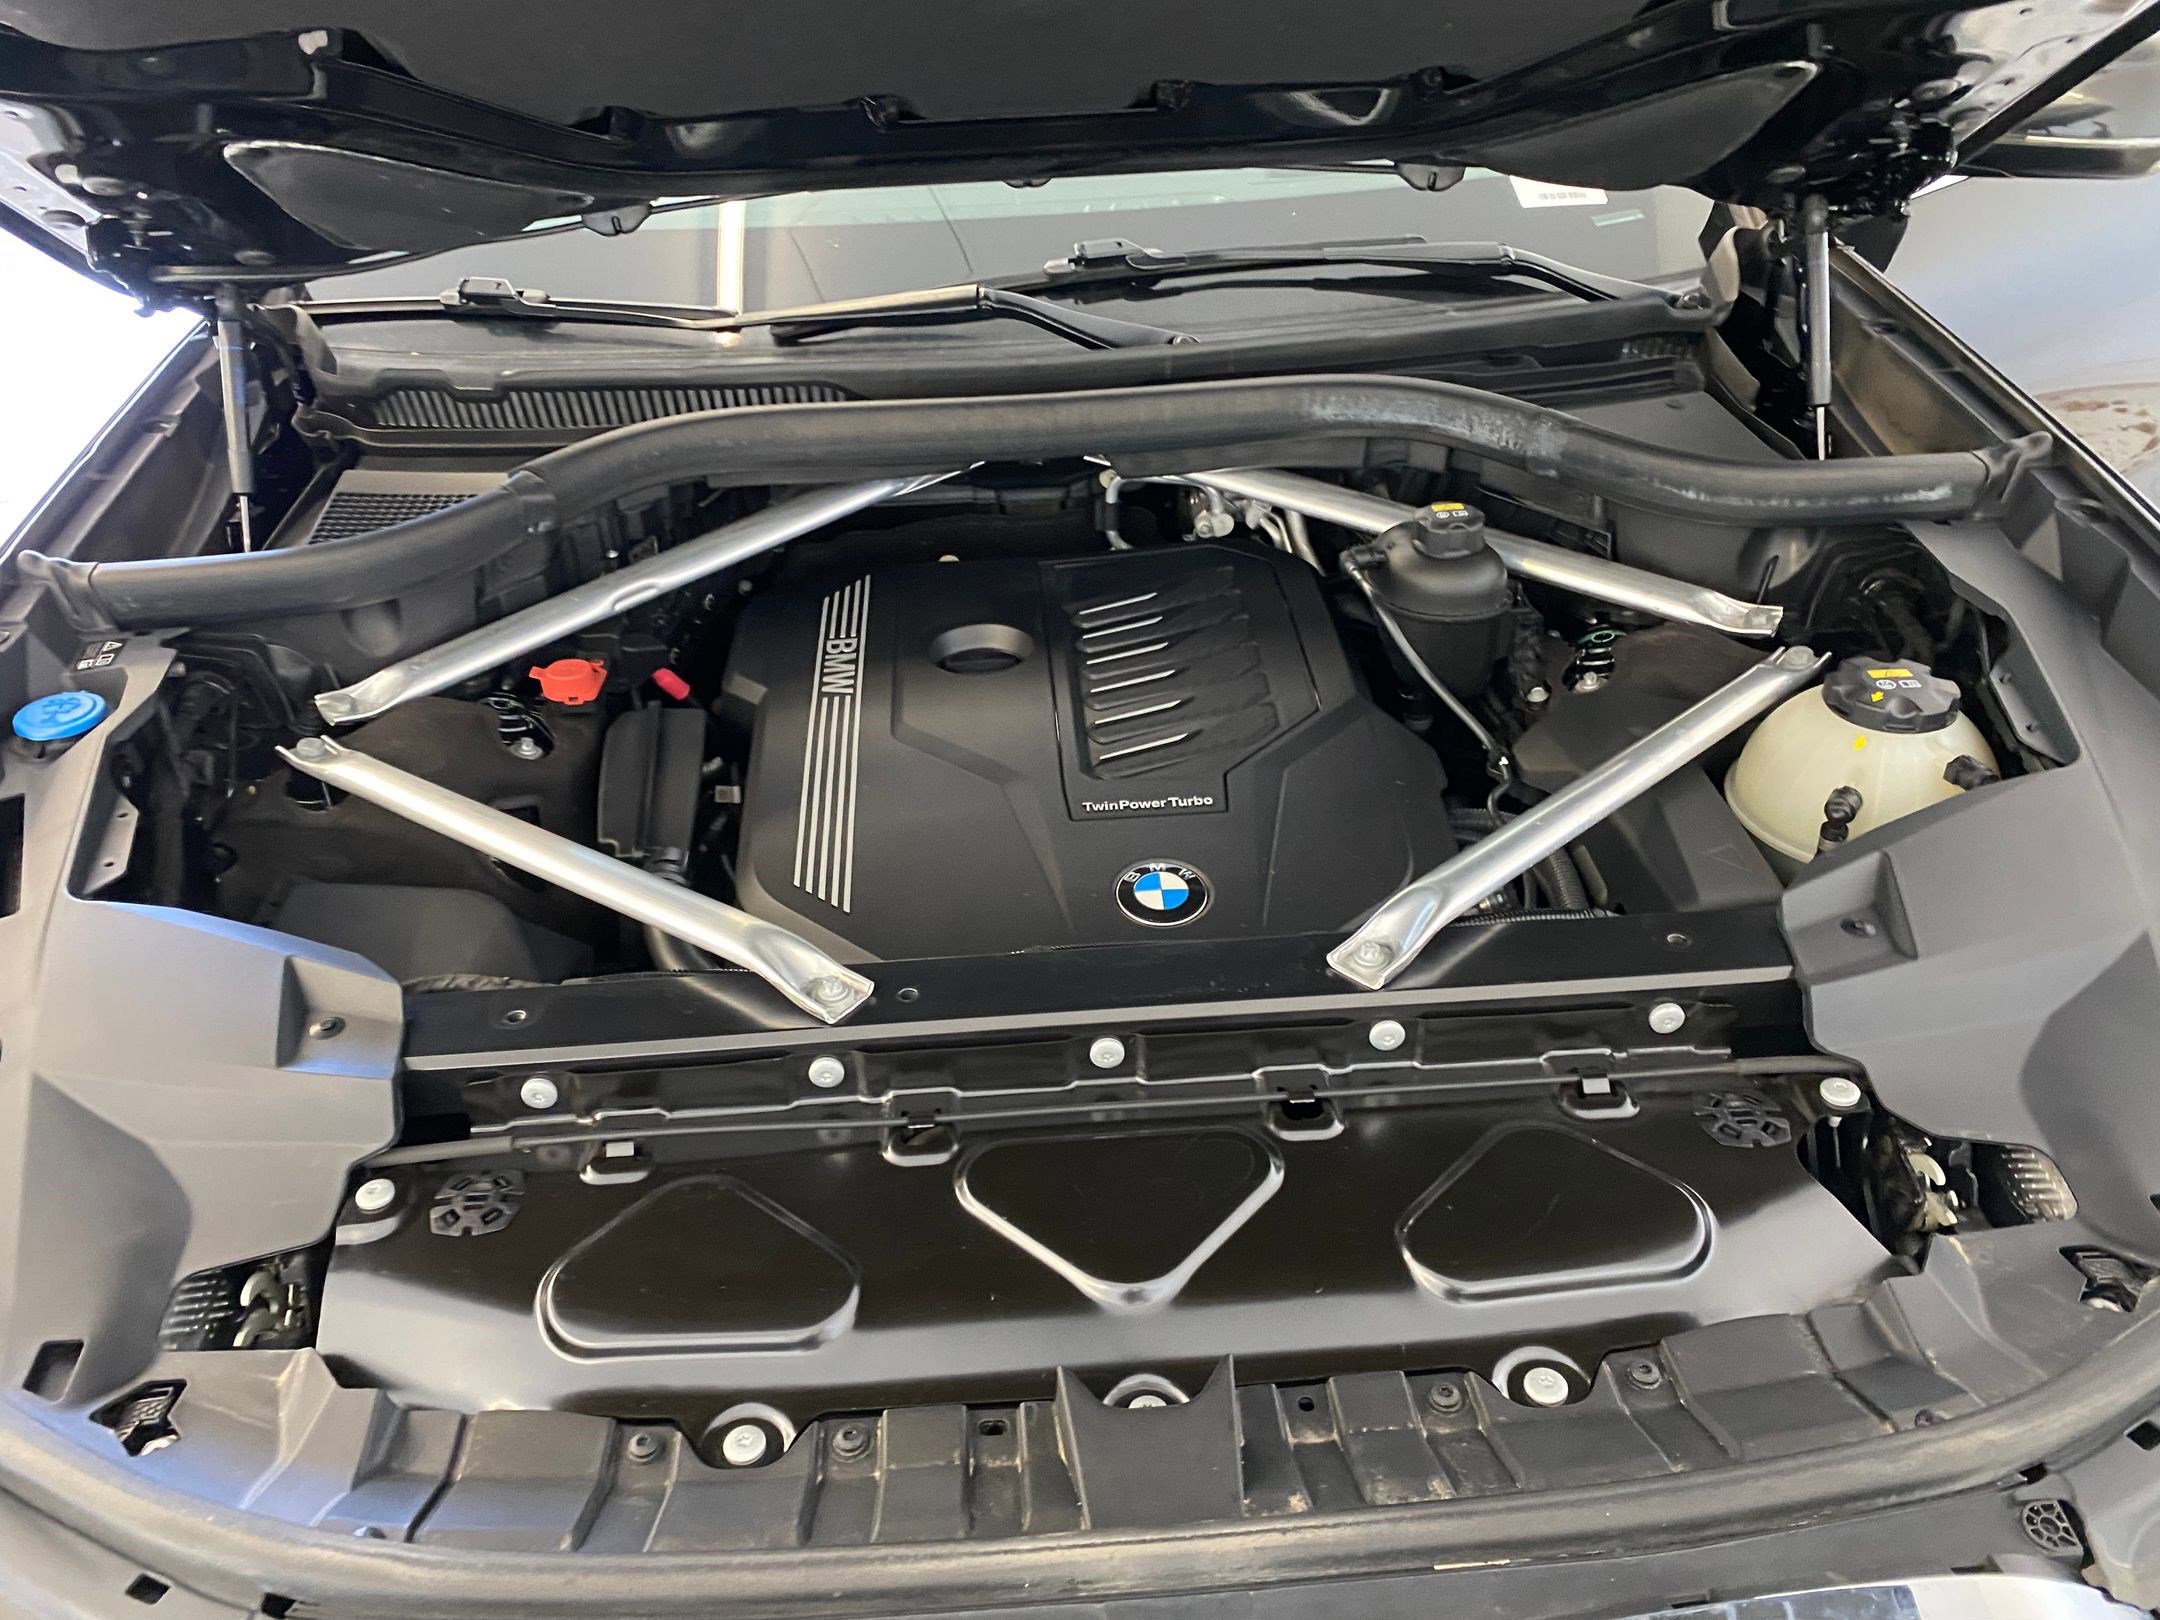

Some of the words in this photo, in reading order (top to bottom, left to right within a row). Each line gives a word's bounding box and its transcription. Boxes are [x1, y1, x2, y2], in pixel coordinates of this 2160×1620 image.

[821, 638, 858, 693] BMW
[1167, 796, 1213, 807] Turbo
[1123, 862, 1196, 883] BMW
